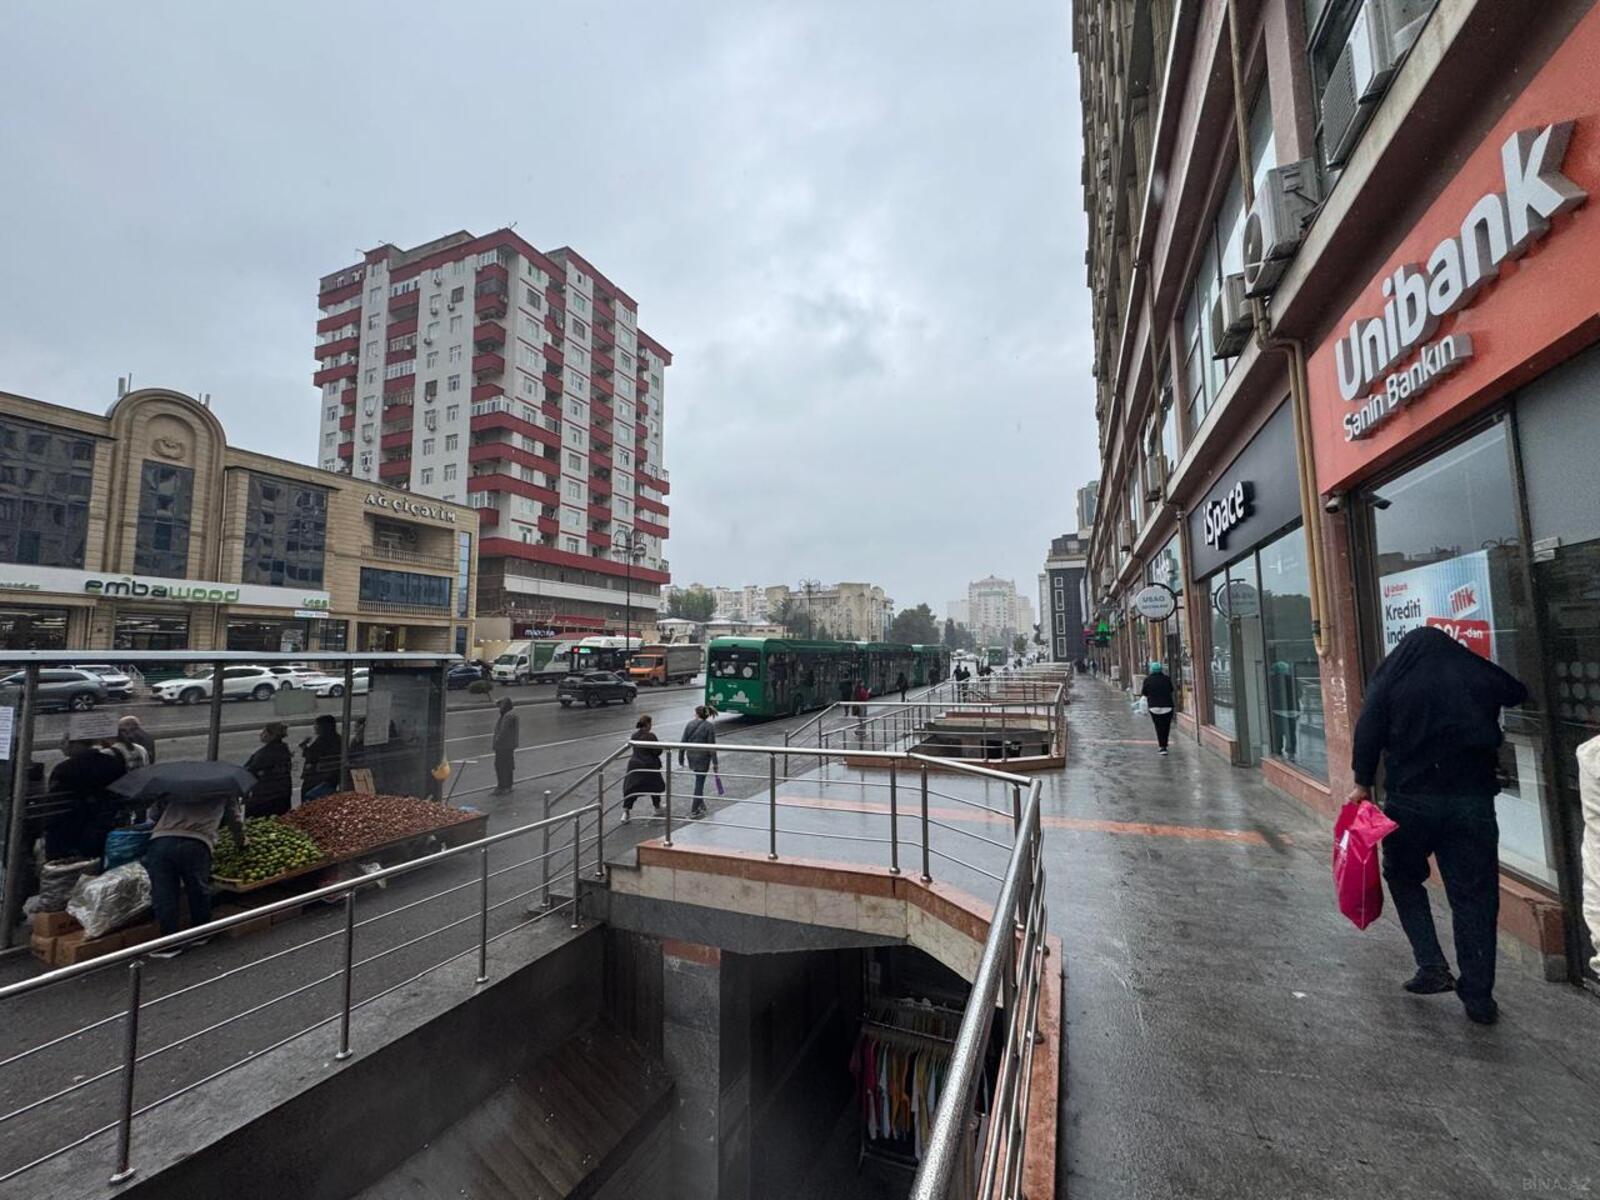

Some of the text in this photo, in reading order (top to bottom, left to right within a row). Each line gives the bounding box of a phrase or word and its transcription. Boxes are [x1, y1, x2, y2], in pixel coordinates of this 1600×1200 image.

[1335, 121, 1582, 401] Unibank
[1203, 480, 1247, 551] iSpace
[85, 577, 240, 602] embawood
[1450, 587, 1477, 614] illik
[1386, 598, 1421, 621] Krediti
